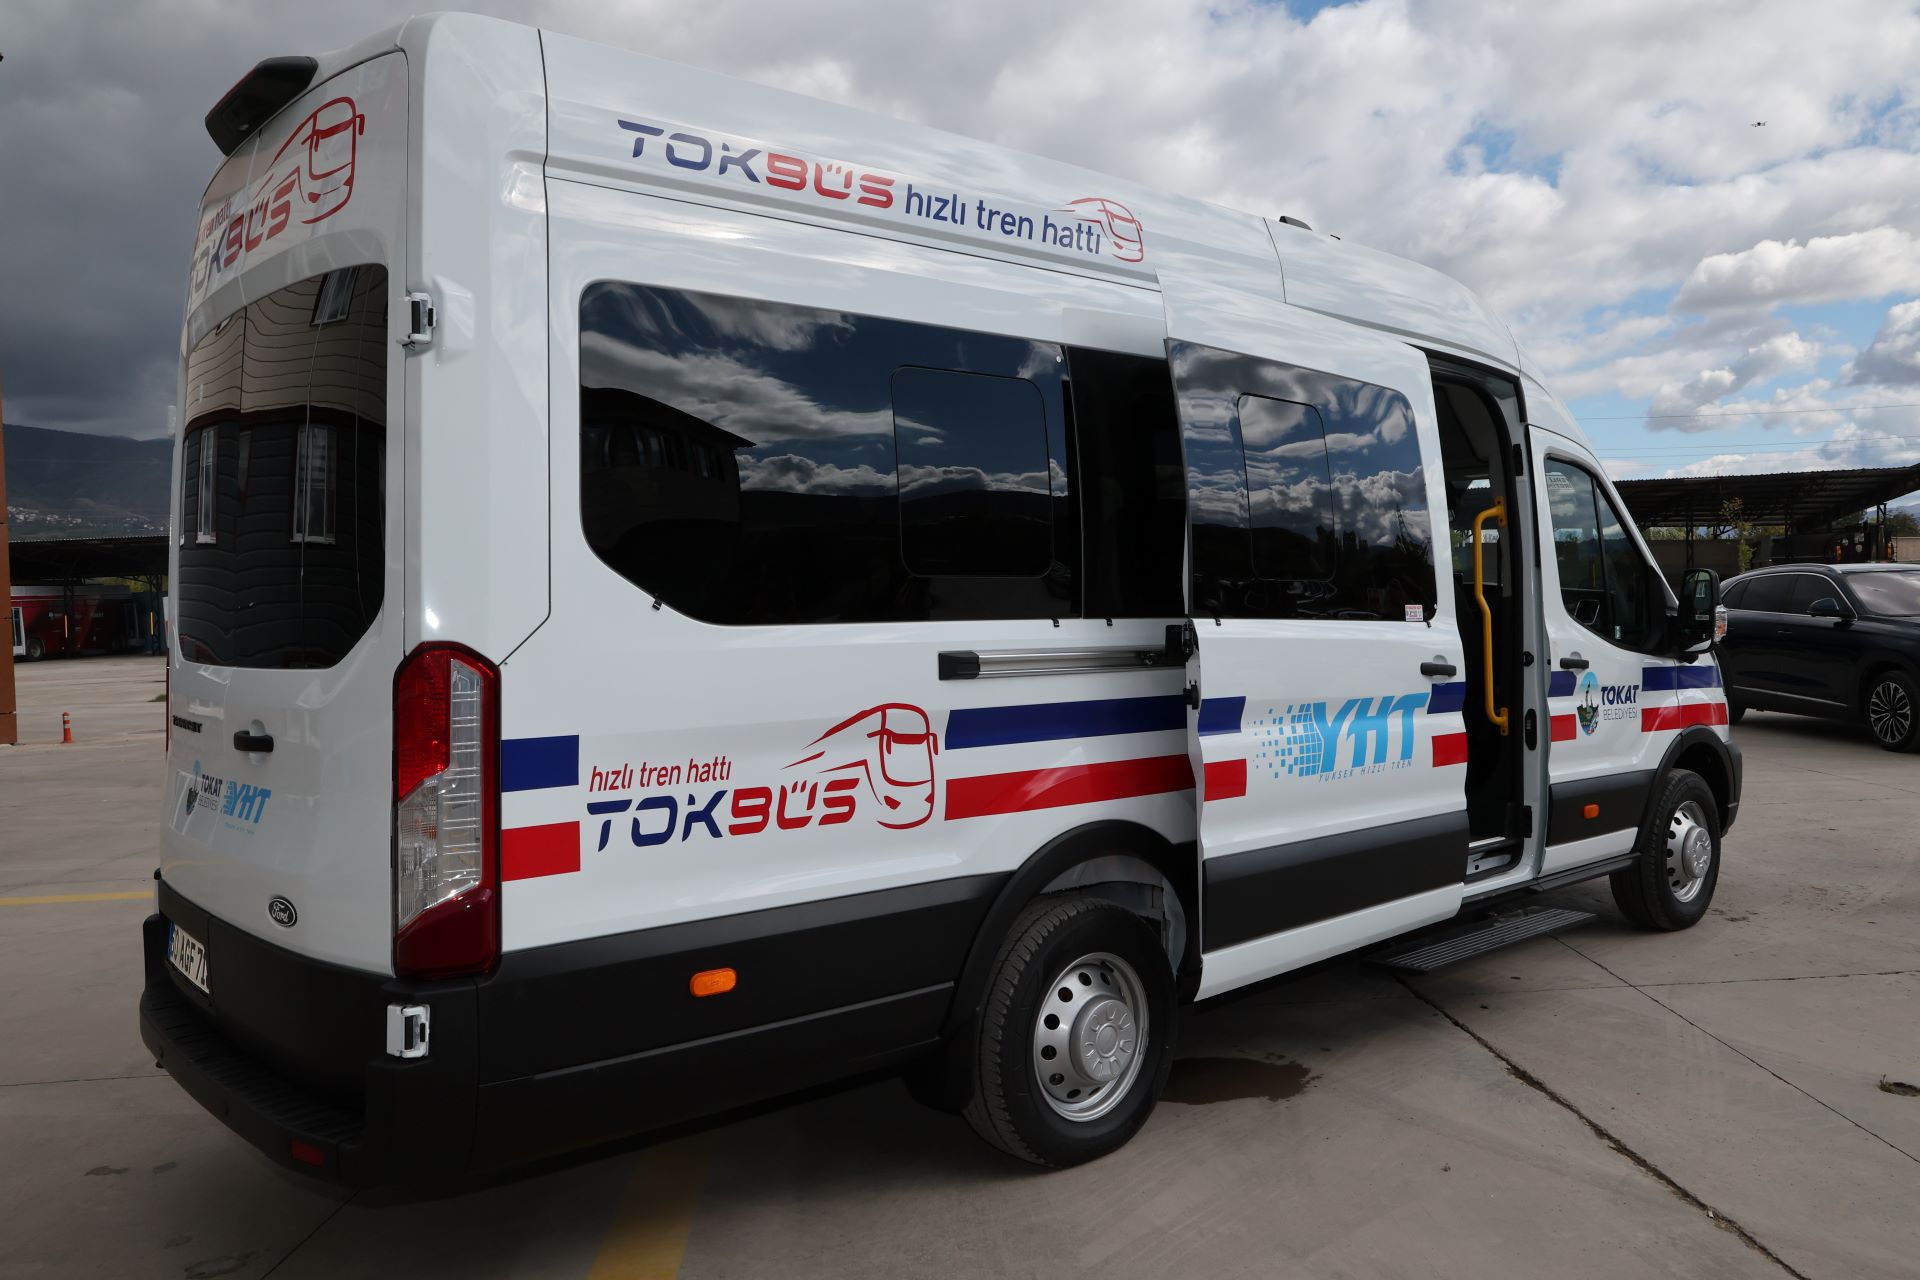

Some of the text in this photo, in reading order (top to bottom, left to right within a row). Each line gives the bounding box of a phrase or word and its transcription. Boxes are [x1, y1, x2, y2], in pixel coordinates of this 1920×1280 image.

[617, 119, 1100, 254] TOKBÜS hızlı tren hattı
[1601, 685, 1639, 705] TOKAT
[1313, 692, 1430, 774] YHT
[201, 774, 223, 797] TOKAT
[589, 755, 732, 792] hızlı tren hattı
[229, 781, 272, 824] YHT
[586, 777, 860, 852] TOKBÜS
[272, 902, 289, 922] Ford
